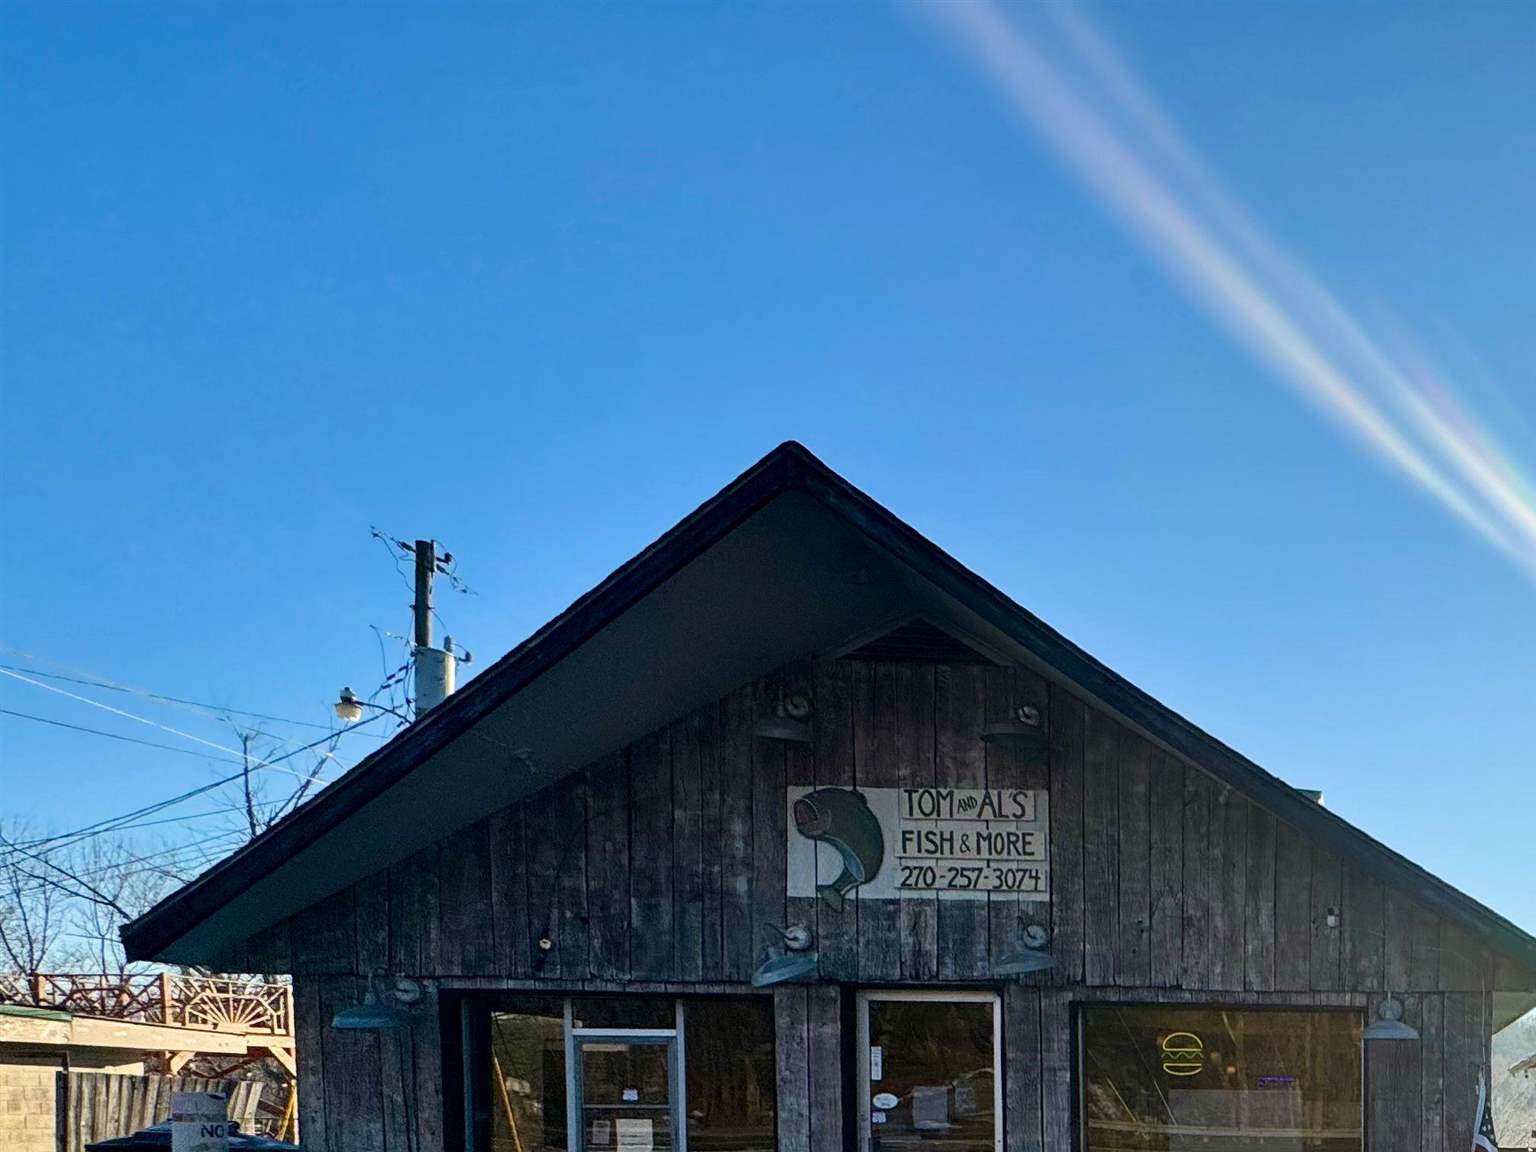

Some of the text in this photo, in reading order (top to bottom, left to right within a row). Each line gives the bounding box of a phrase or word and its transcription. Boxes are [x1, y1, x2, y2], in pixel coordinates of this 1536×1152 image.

[903, 789, 1028, 819] TOM AND AL'S
[901, 830, 1035, 857] FISH & MORE
[900, 866, 1042, 891] 270-257-3074
[201, 1124, 225, 1138] NO
